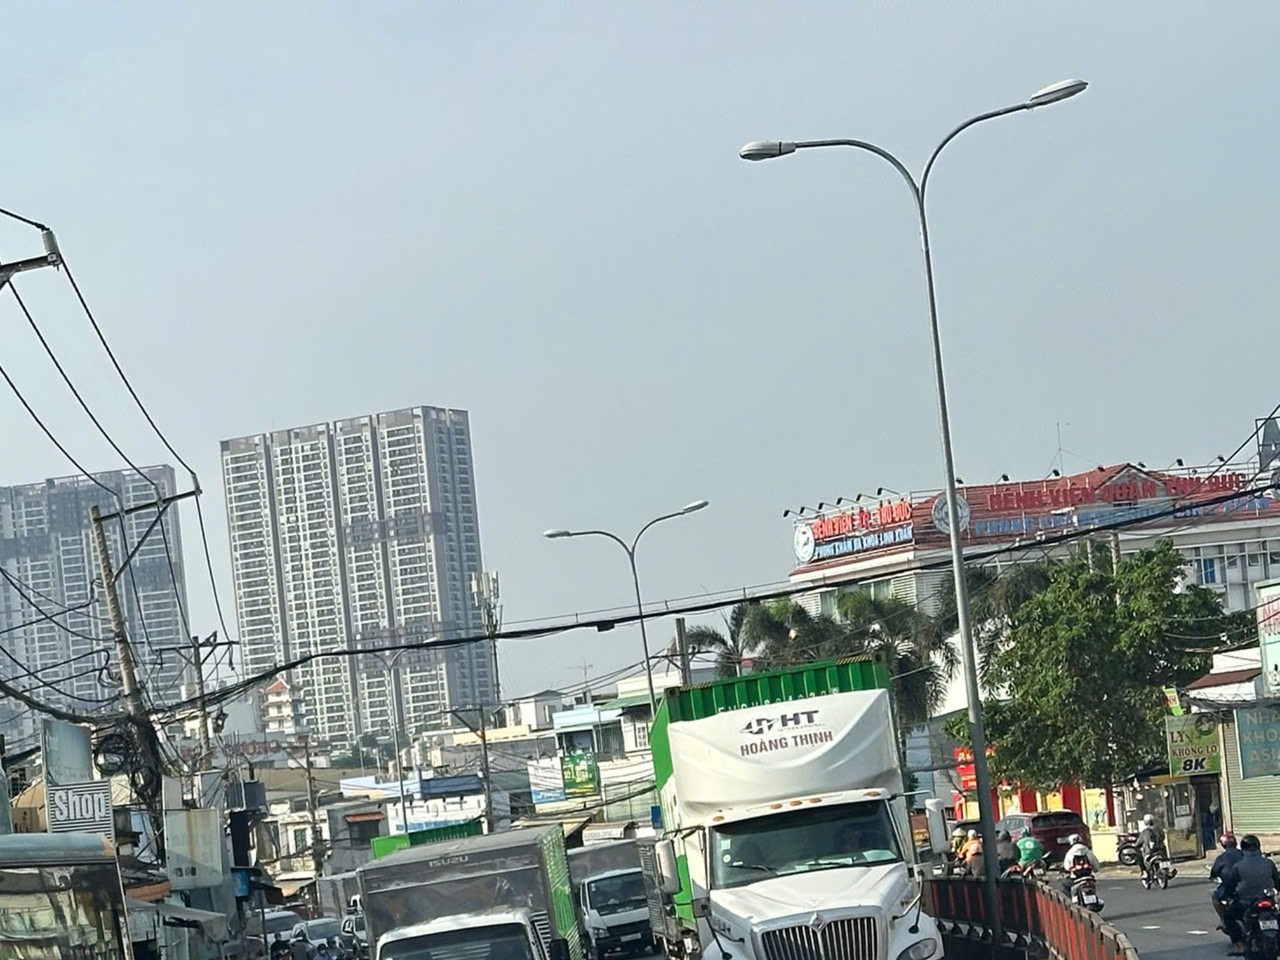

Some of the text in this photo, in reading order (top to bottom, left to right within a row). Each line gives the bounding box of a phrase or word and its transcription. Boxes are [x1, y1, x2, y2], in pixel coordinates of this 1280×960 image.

[780, 710, 820, 728] HT
[740, 730, 834, 757] HOÀNG THỊNH
[1182, 757, 1207, 772] 8K
[54, 788, 106, 822] Shop
[429, 855, 469, 868] ISUZU
